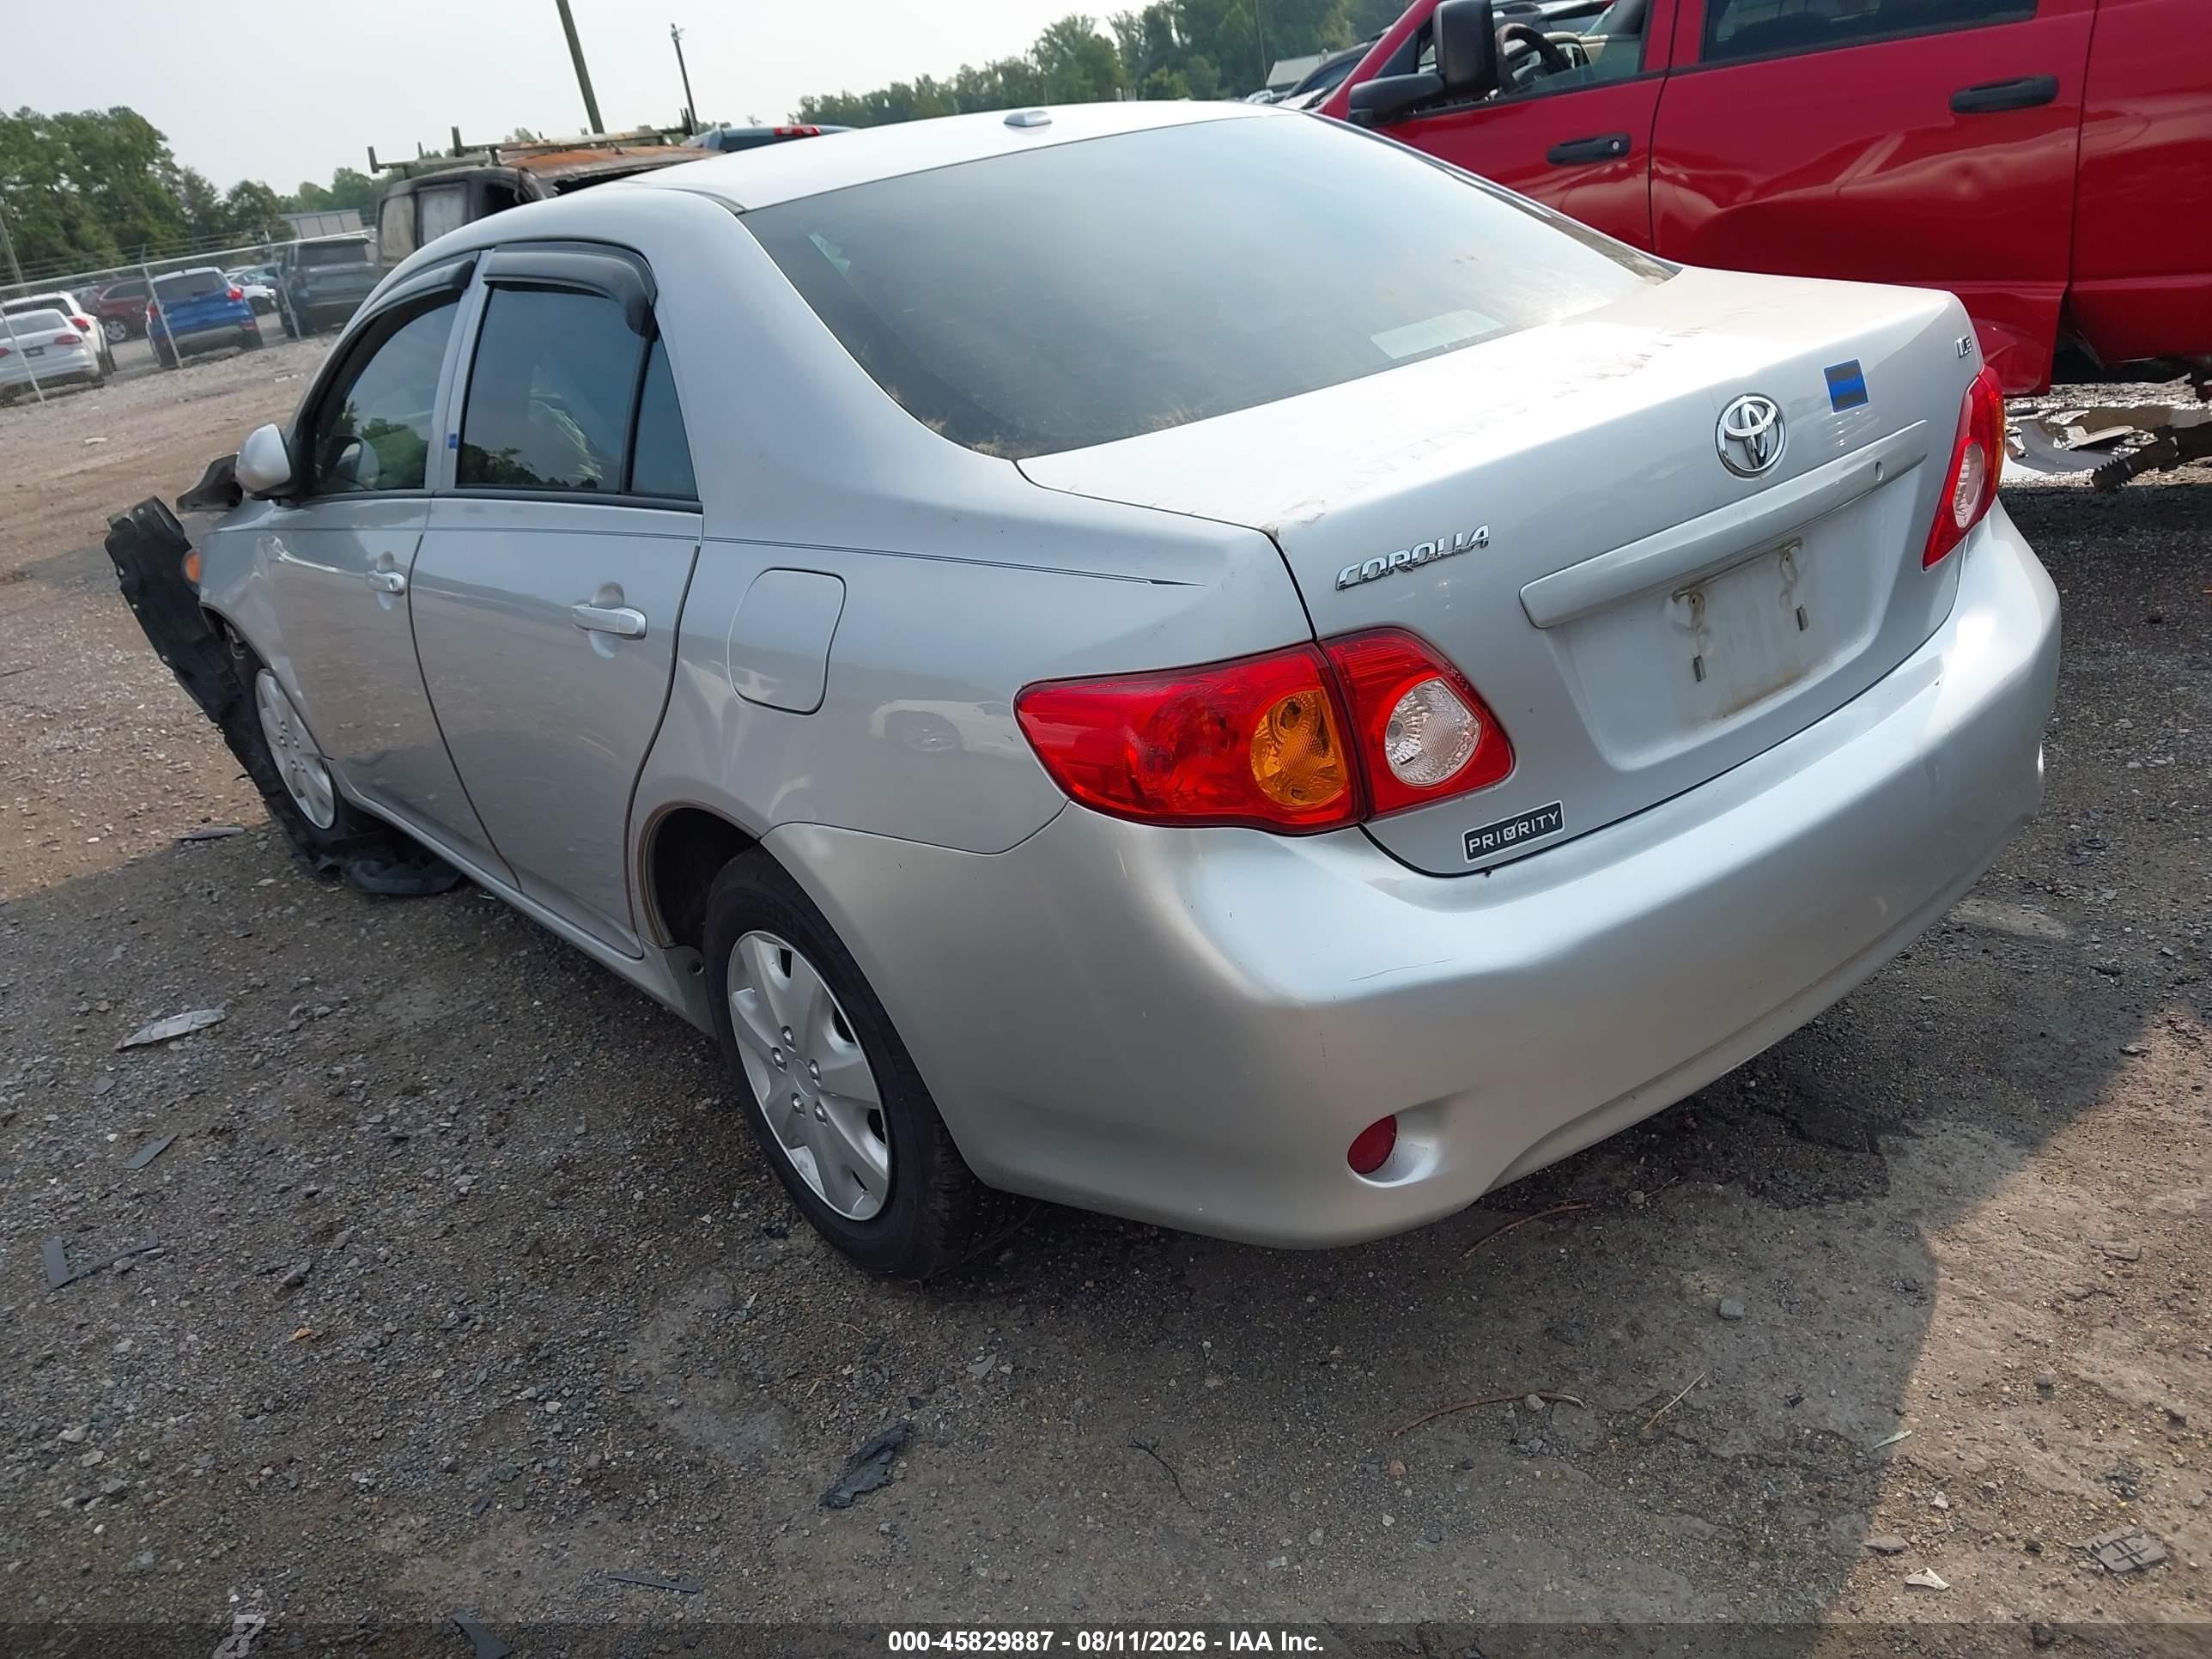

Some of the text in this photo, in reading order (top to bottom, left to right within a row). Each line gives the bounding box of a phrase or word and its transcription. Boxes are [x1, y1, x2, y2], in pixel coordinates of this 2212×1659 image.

[1955, 336, 1972, 358] LE
[1335, 524, 1490, 591] COROLLA
[1468, 810, 1559, 854] PRIORITY
